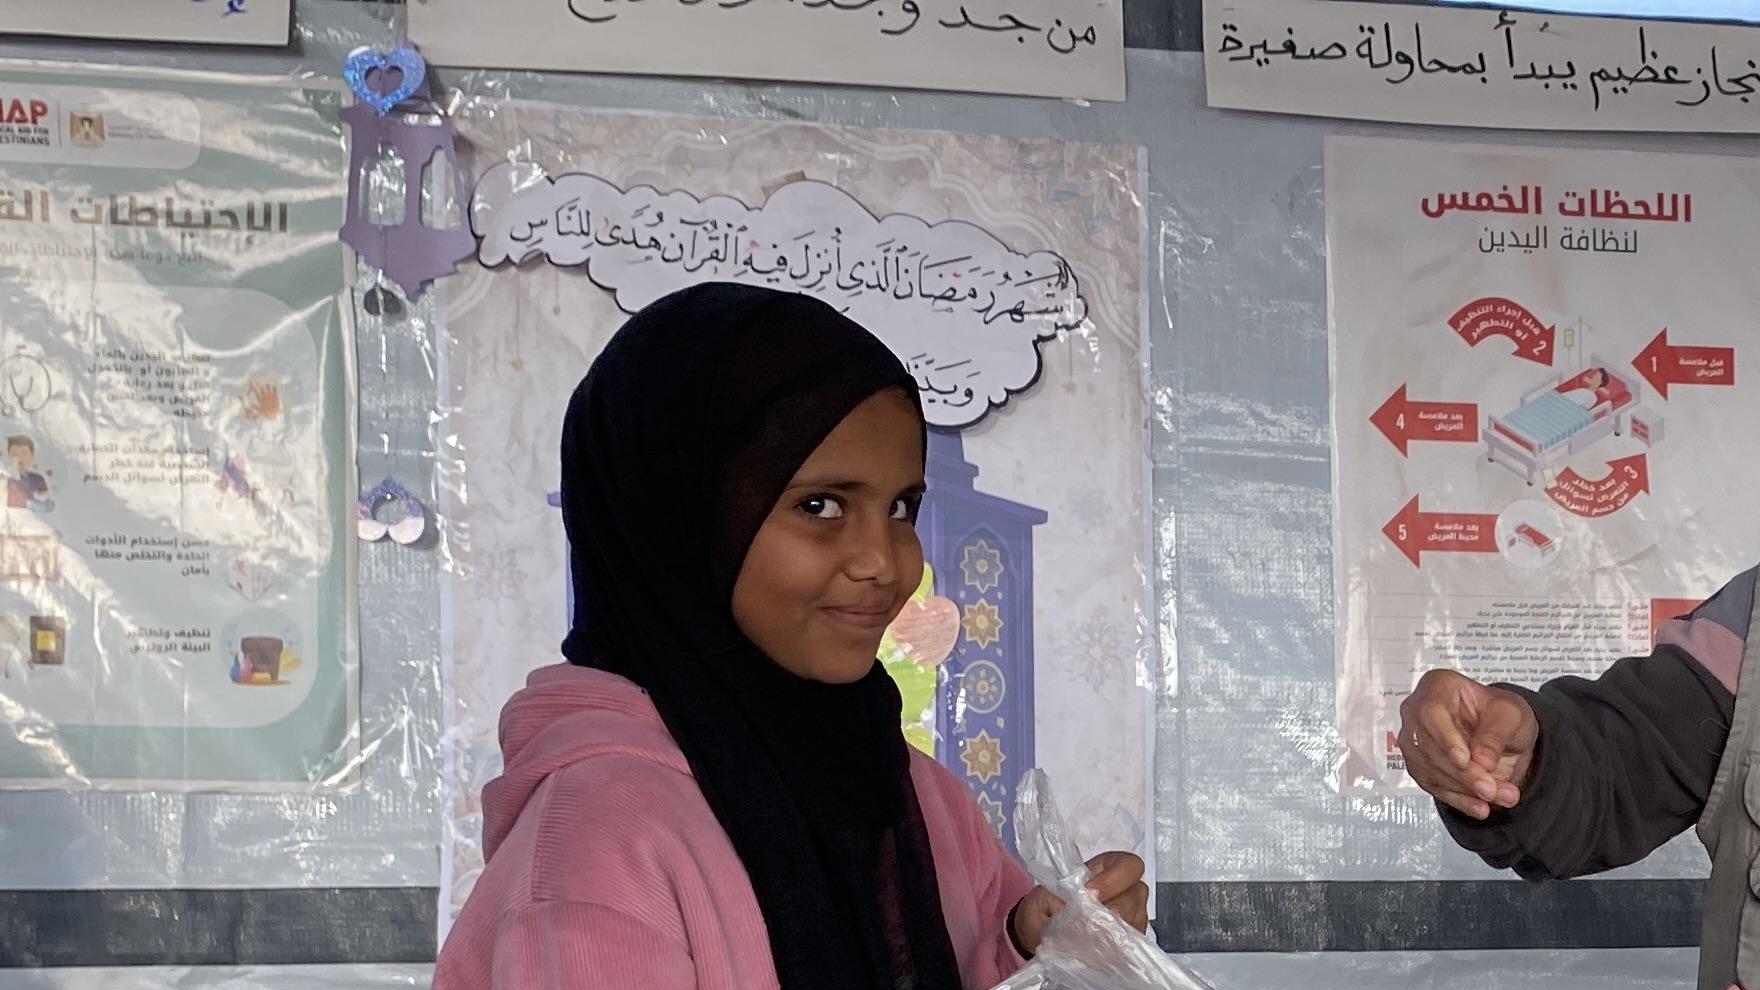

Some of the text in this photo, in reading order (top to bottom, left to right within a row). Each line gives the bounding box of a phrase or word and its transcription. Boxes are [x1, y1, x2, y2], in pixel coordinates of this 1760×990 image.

[1047, 17, 1097, 53] من
[1356, 22, 1487, 84] بمحاولة
[1494, 10, 1577, 90] يبدأ
[1589, 26, 1692, 110] عظيم
[0, 98, 49, 125] AP
[1421, 185, 1691, 223] اللحظات الخمس
[1478, 225, 1638, 255] لنظافة اليدين
[1532, 340, 1548, 356] 2
[1650, 355, 1658, 374] 1
[1396, 412, 1405, 430] 4
[1623, 465, 1639, 480] 3
[1398, 523, 1408, 541] 5
